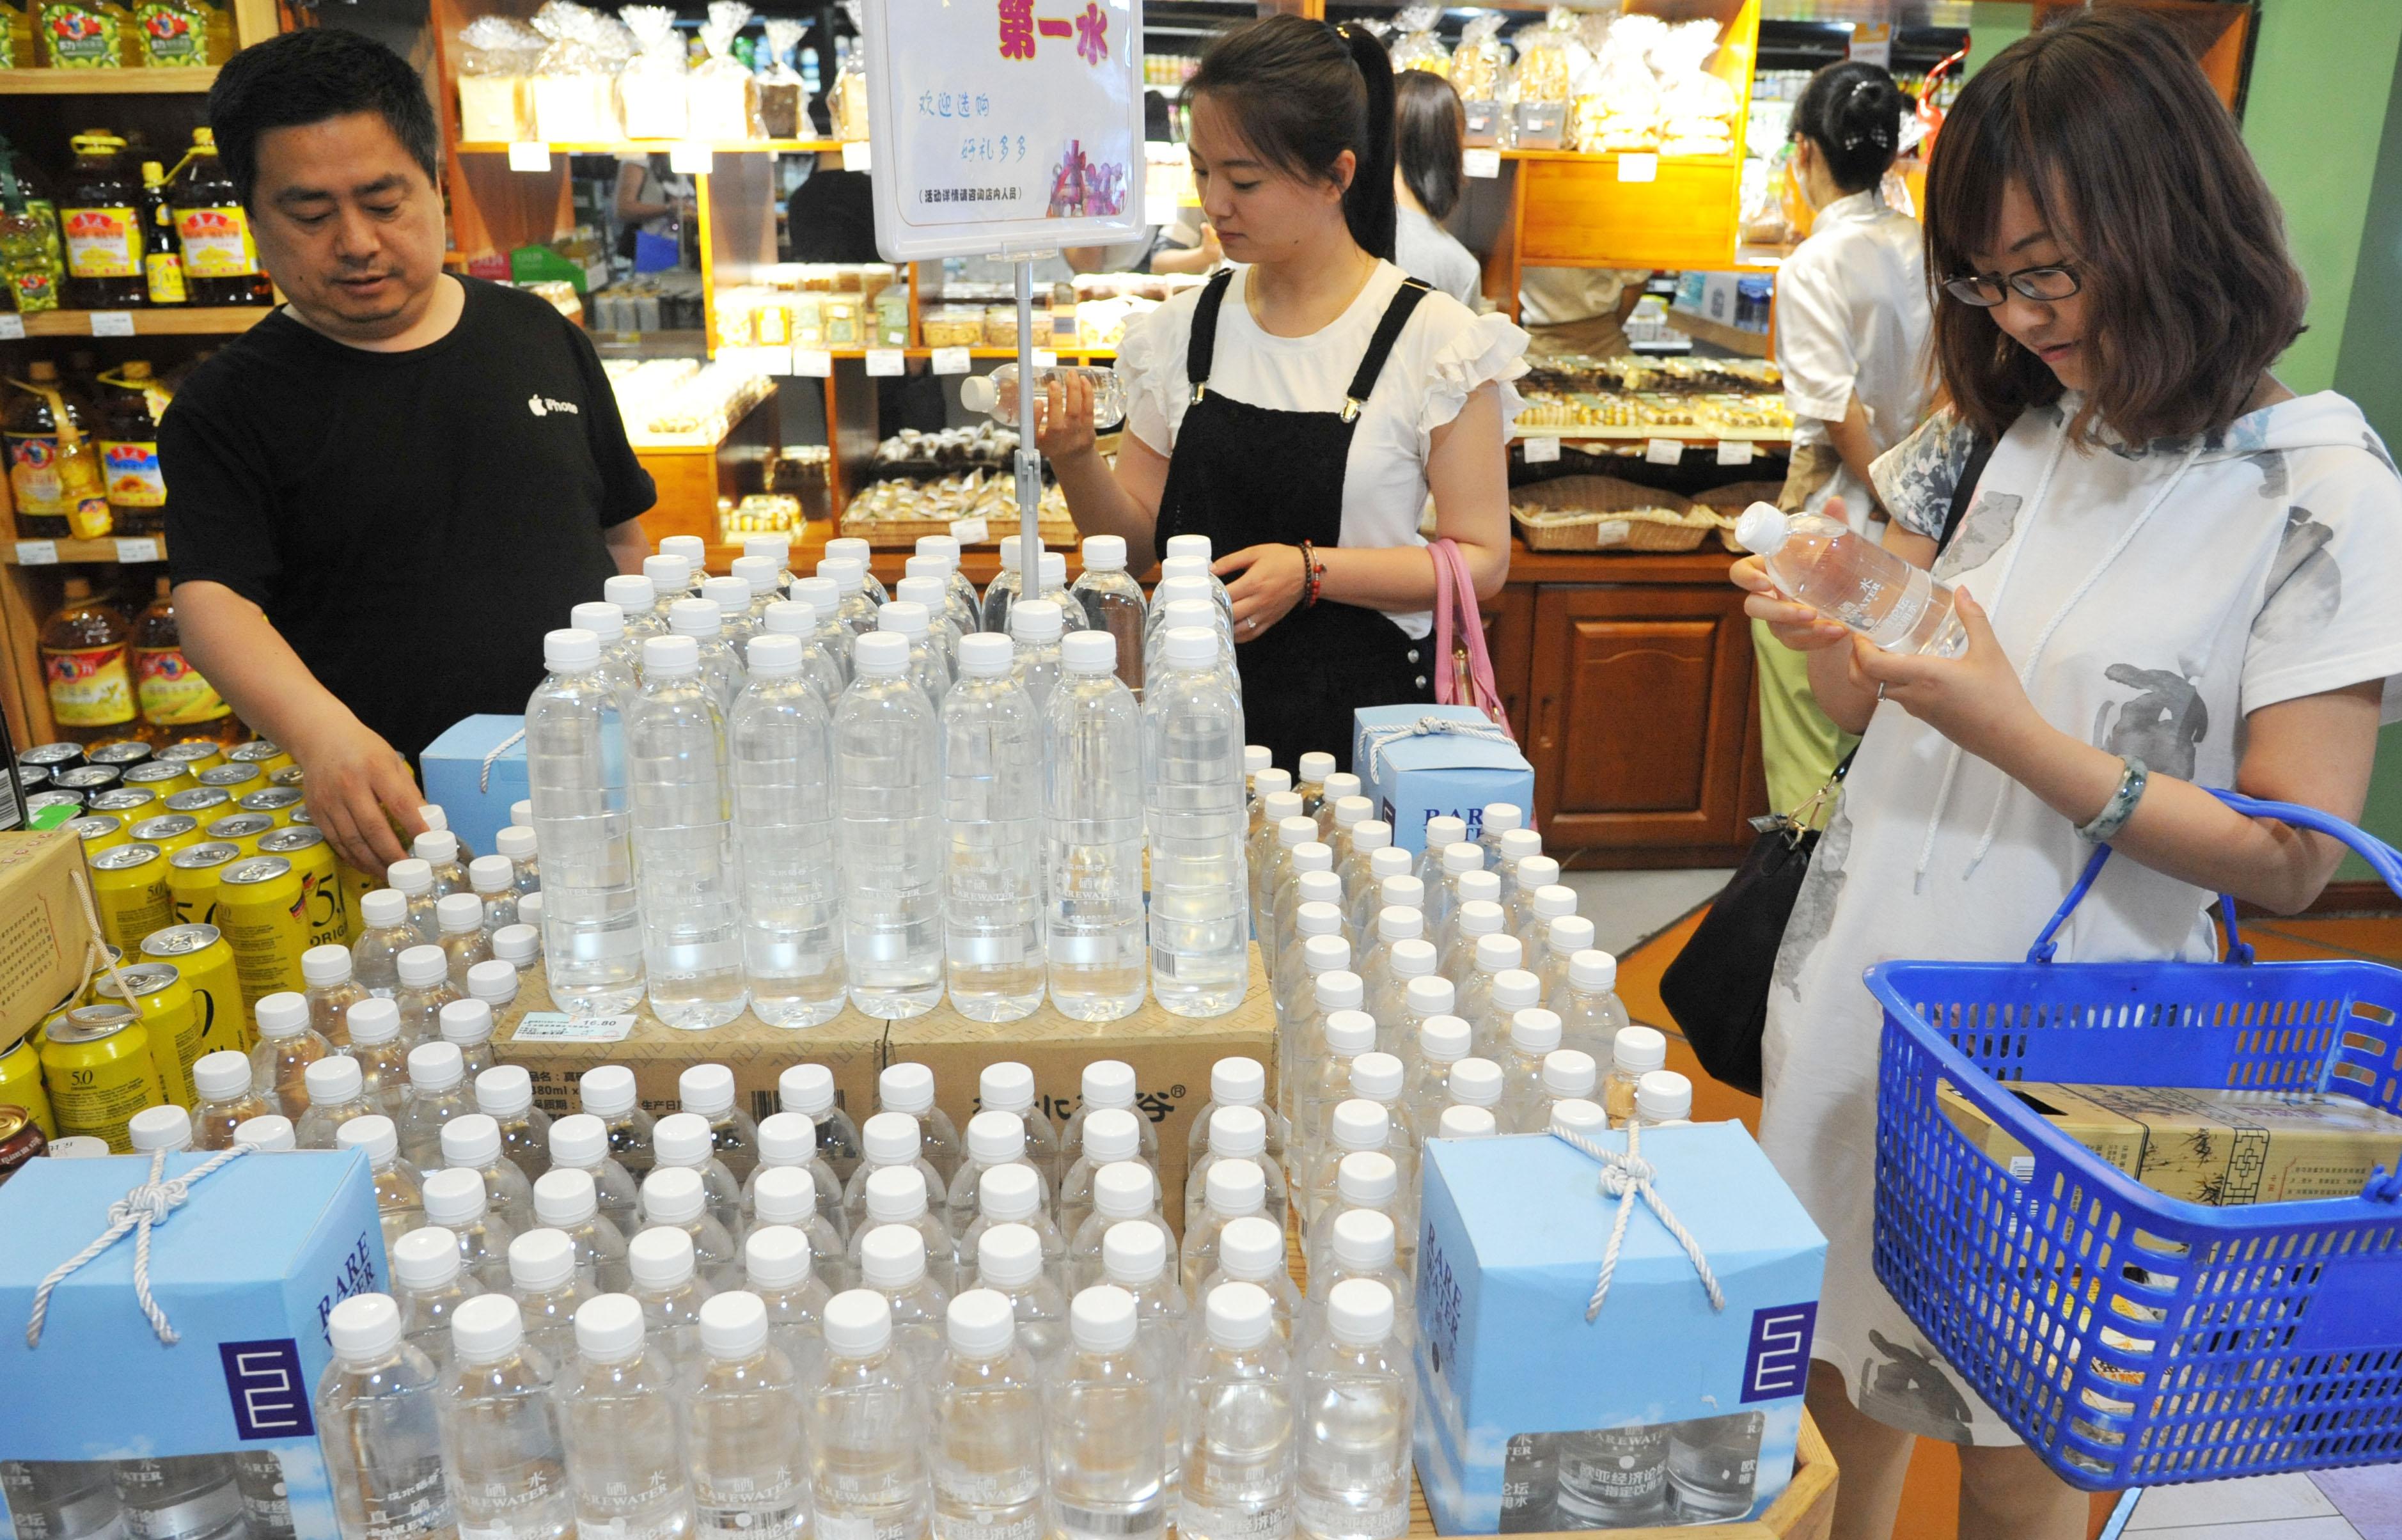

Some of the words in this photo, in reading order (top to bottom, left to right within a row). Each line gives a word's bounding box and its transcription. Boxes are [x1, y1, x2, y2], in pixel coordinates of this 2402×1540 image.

[998, 0, 1108, 66] 第一水
[918, 90, 989, 118] 欢迎选购
[961, 135, 1026, 163] 好礼多多
